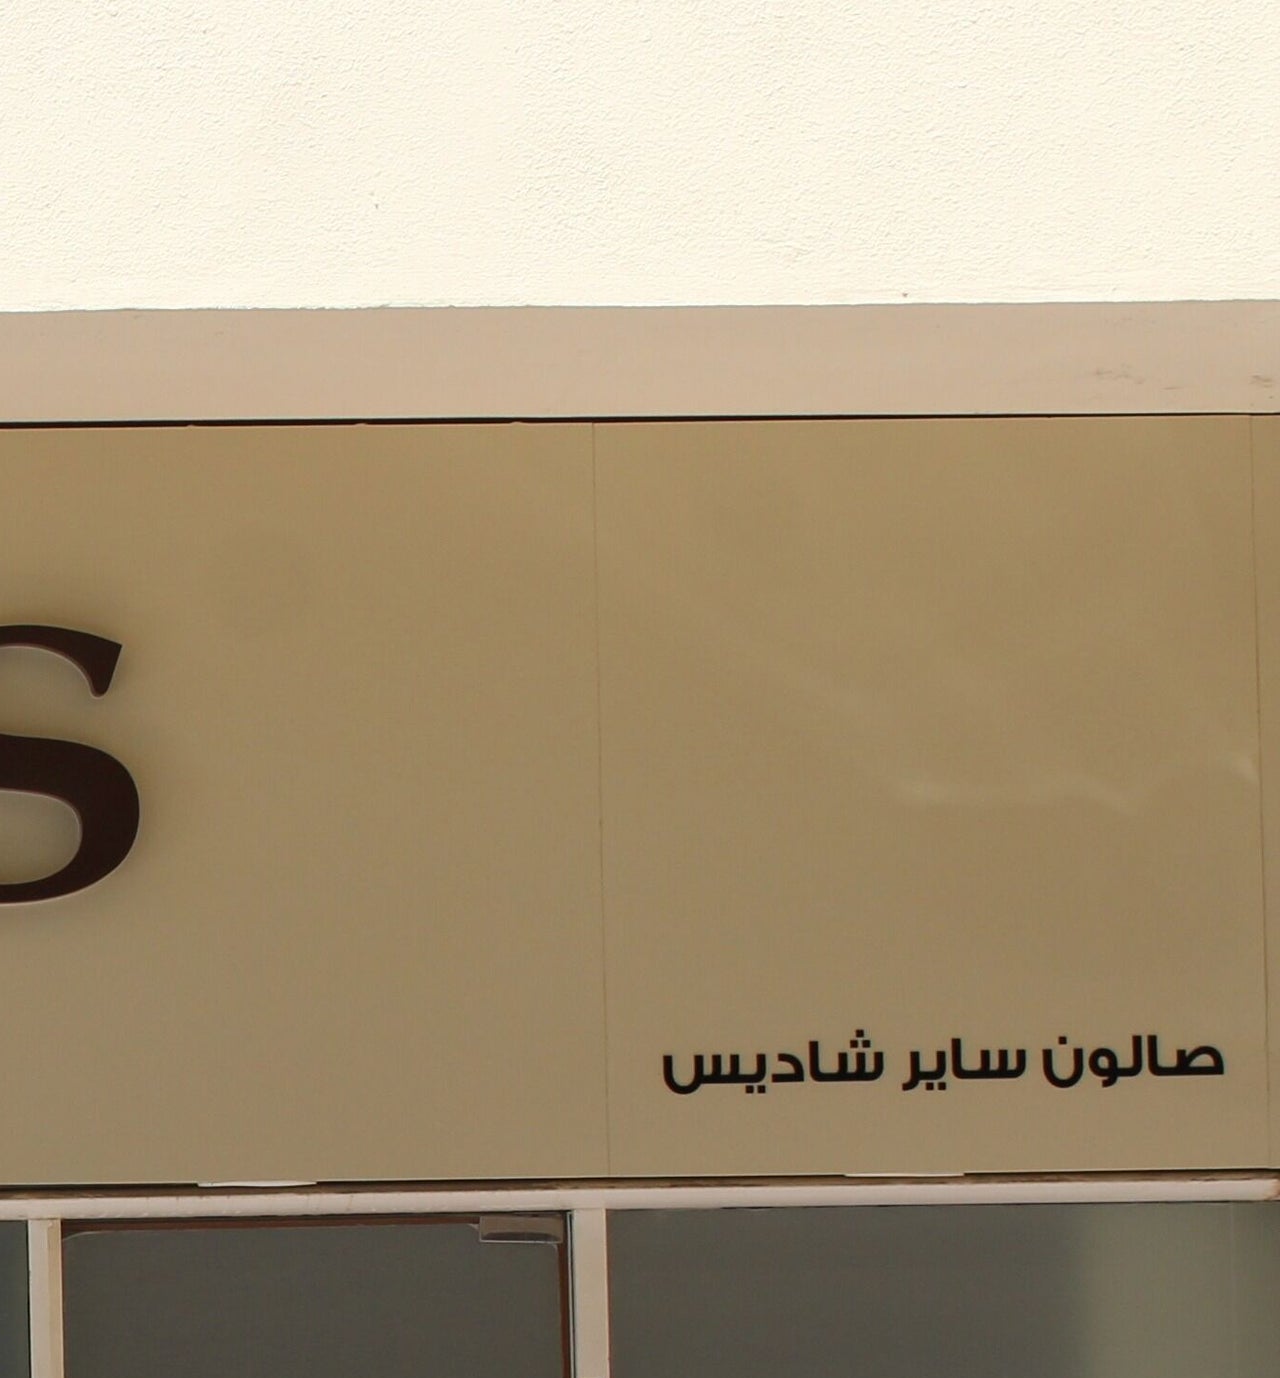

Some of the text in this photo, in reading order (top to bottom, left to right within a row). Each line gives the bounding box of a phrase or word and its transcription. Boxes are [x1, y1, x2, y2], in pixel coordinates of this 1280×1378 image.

[662, 1029, 1225, 1095] صالون ساير شاديس
